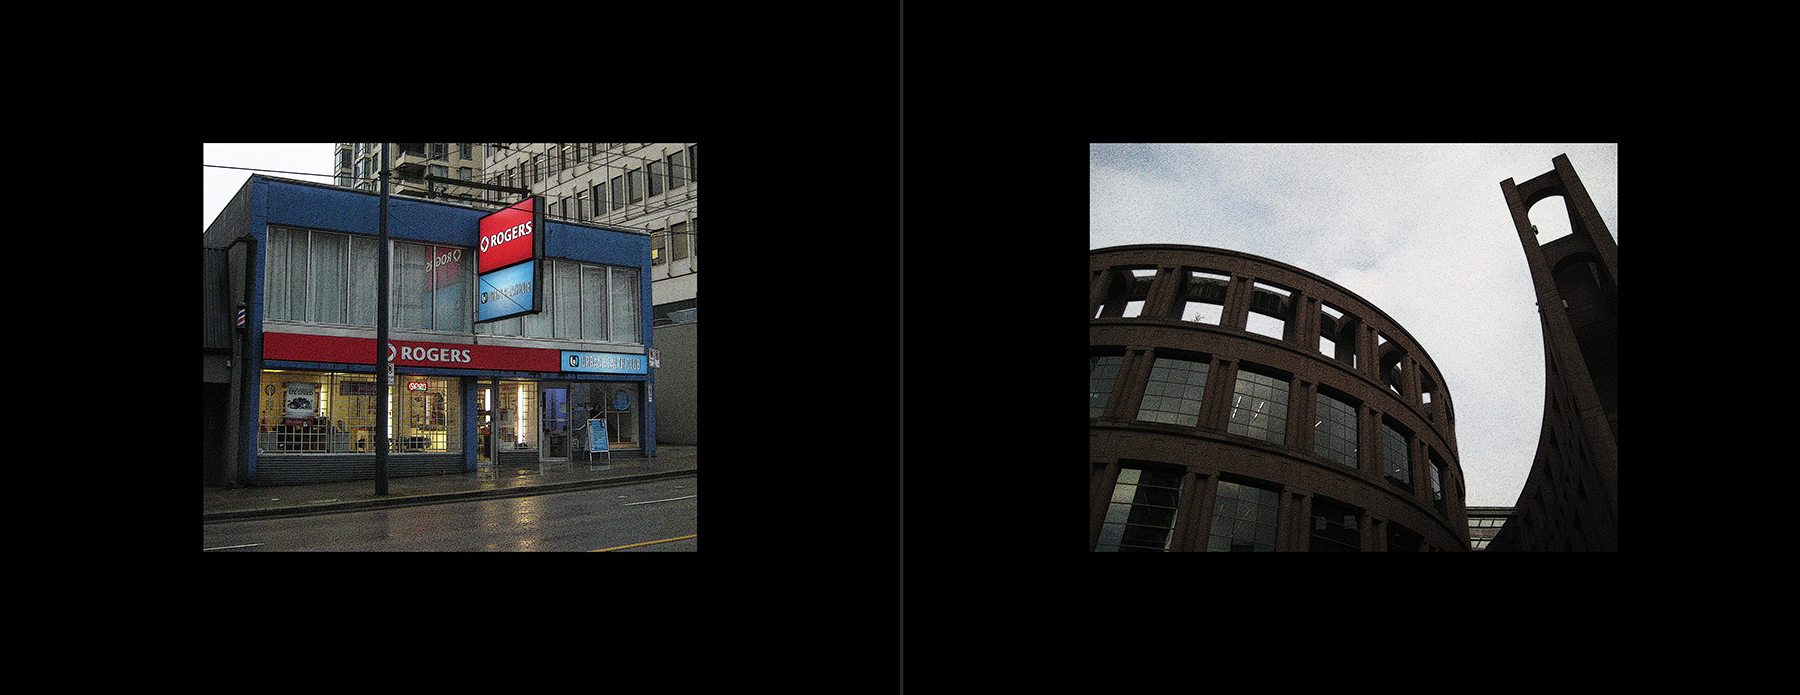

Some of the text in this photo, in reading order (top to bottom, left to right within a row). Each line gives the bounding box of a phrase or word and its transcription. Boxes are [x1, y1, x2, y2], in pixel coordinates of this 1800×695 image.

[490, 221, 532, 248] ROGERS
[401, 346, 471, 363] ROGERS
[581, 356, 602, 368] URBAN
[603, 357, 625, 369] HEALTH
[626, 358, 641, 370] CLUB
